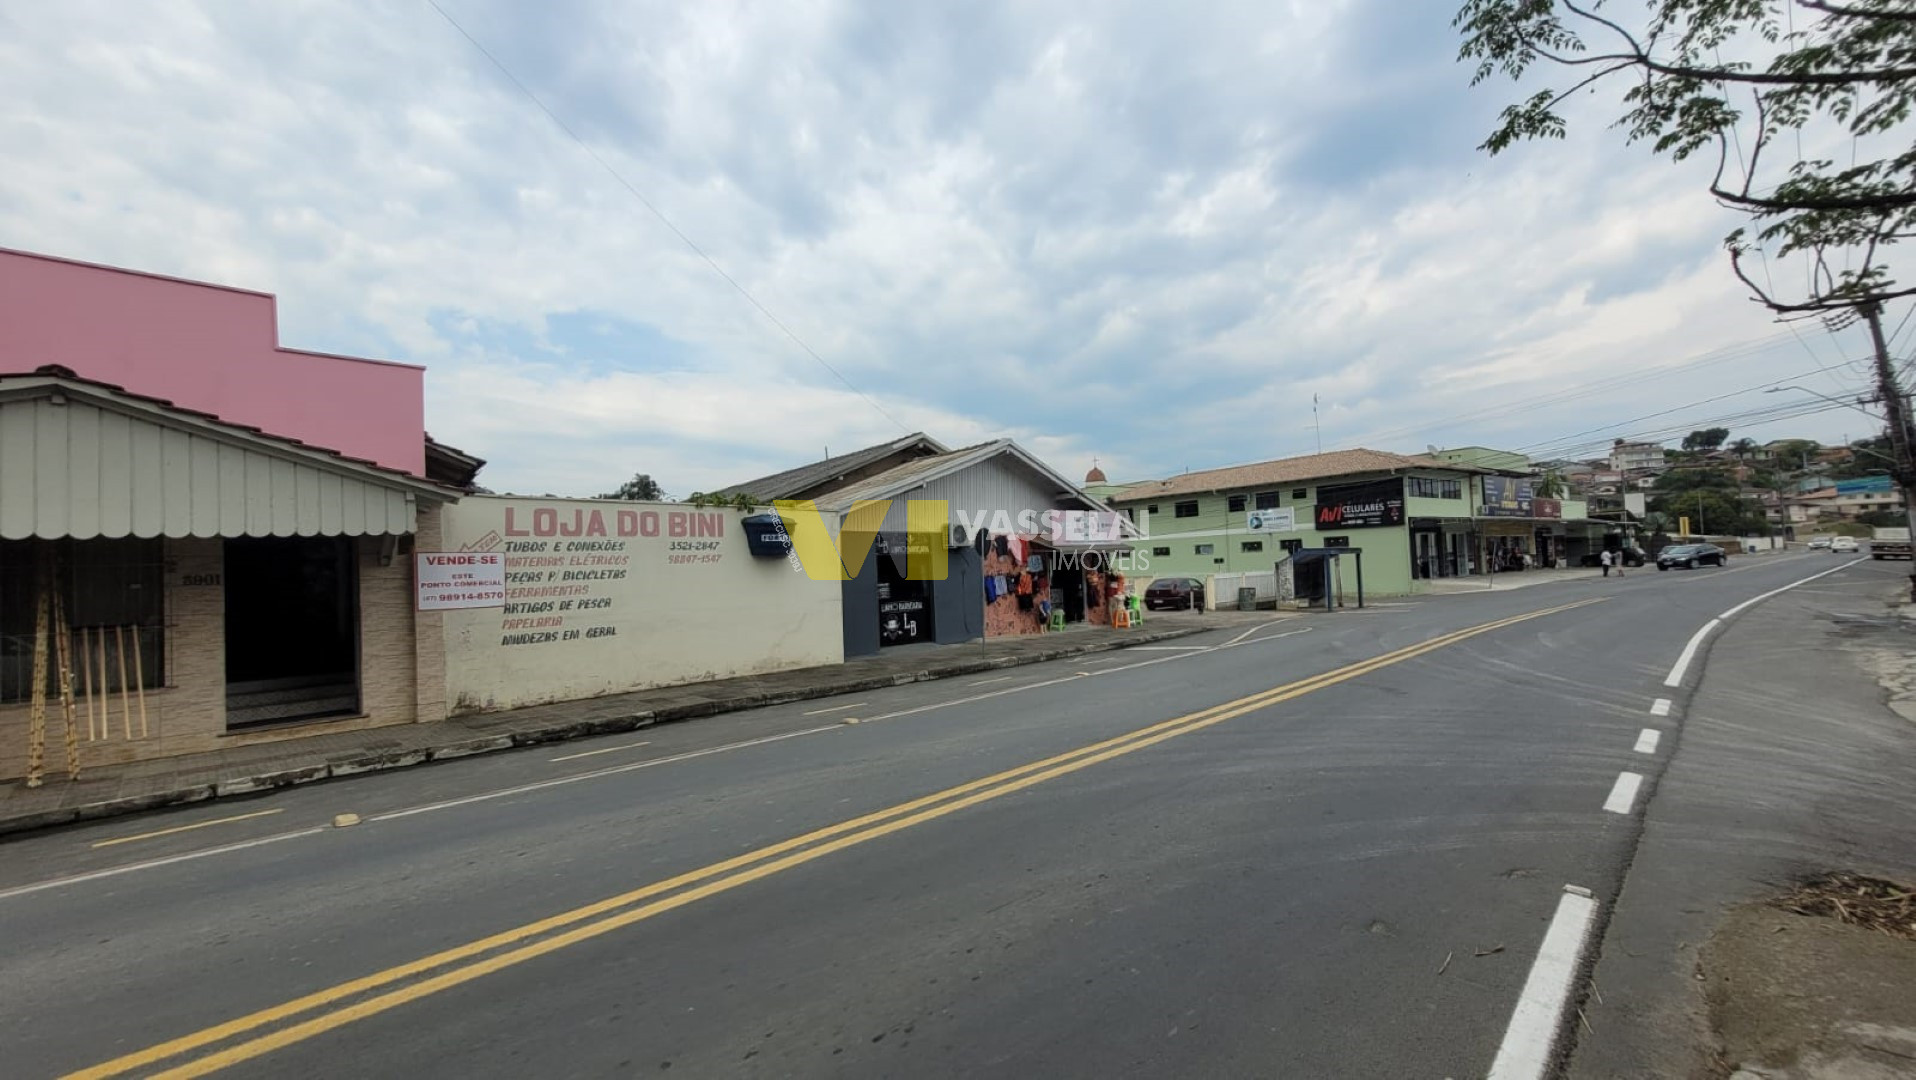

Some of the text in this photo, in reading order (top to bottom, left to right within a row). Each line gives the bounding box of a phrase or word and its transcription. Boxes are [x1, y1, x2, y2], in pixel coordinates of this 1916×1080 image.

[1342, 503, 1385, 513] CELULARES
[505, 507, 724, 538] LOJA DO BINI
[505, 539, 626, 552] TUBOS E CONEXÕES
[426, 555, 498, 566] VENDE-SE
[505, 553, 630, 567] MATERIAIS ELÉTRICOS
[454, 580, 503, 588] COMERCIAL
[505, 571, 542, 585] PEÇAS
[562, 569, 627, 581] BICICLETAS
[505, 585, 589, 599] FERRAMENTAS
[503, 597, 612, 614] ARTIGOS DE PESCA
[502, 616, 564, 630] PAPELARIA
[501, 626, 617, 646] MIUDEZAS EM GERAL
